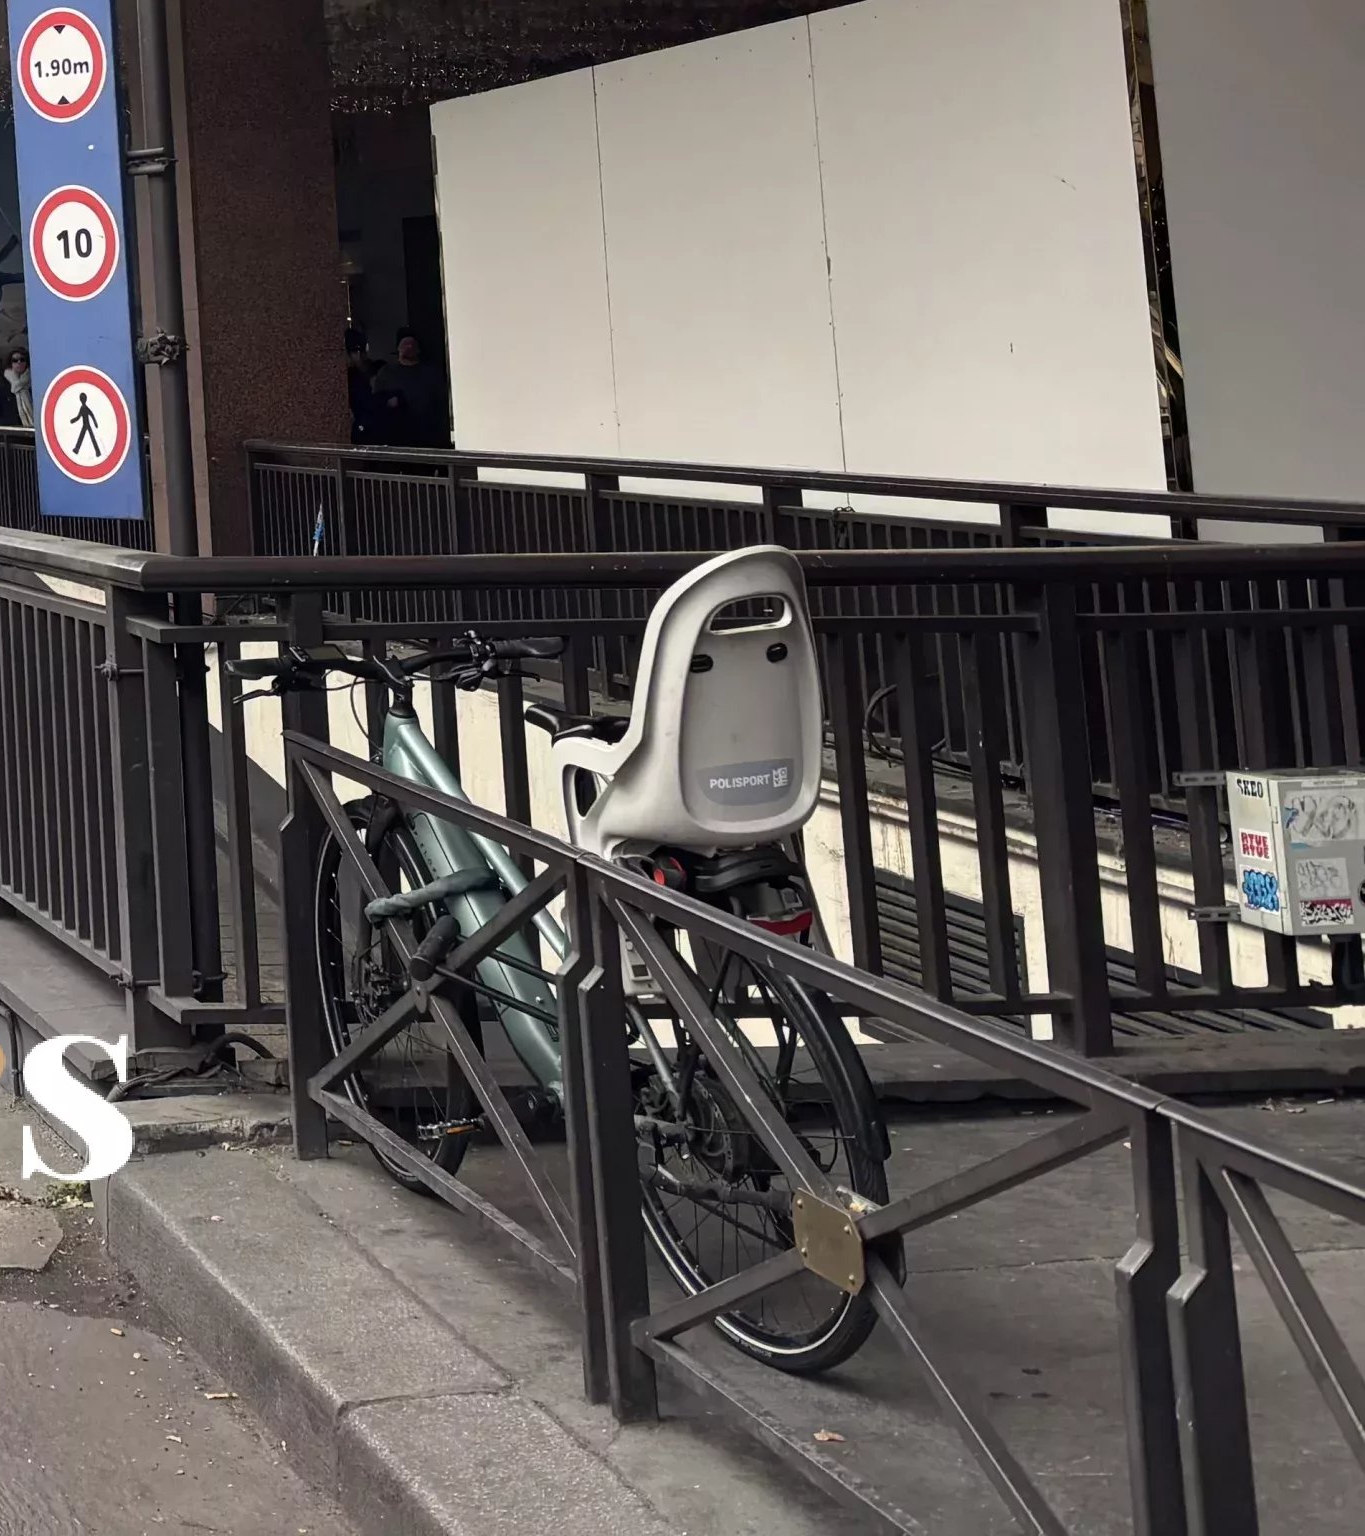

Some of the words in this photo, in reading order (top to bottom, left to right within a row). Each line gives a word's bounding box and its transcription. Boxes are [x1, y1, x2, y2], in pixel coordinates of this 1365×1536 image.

[34, 57, 90, 78] 1.90m
[56, 227, 92, 260] 10
[709, 774, 770, 789] POLISPORT
